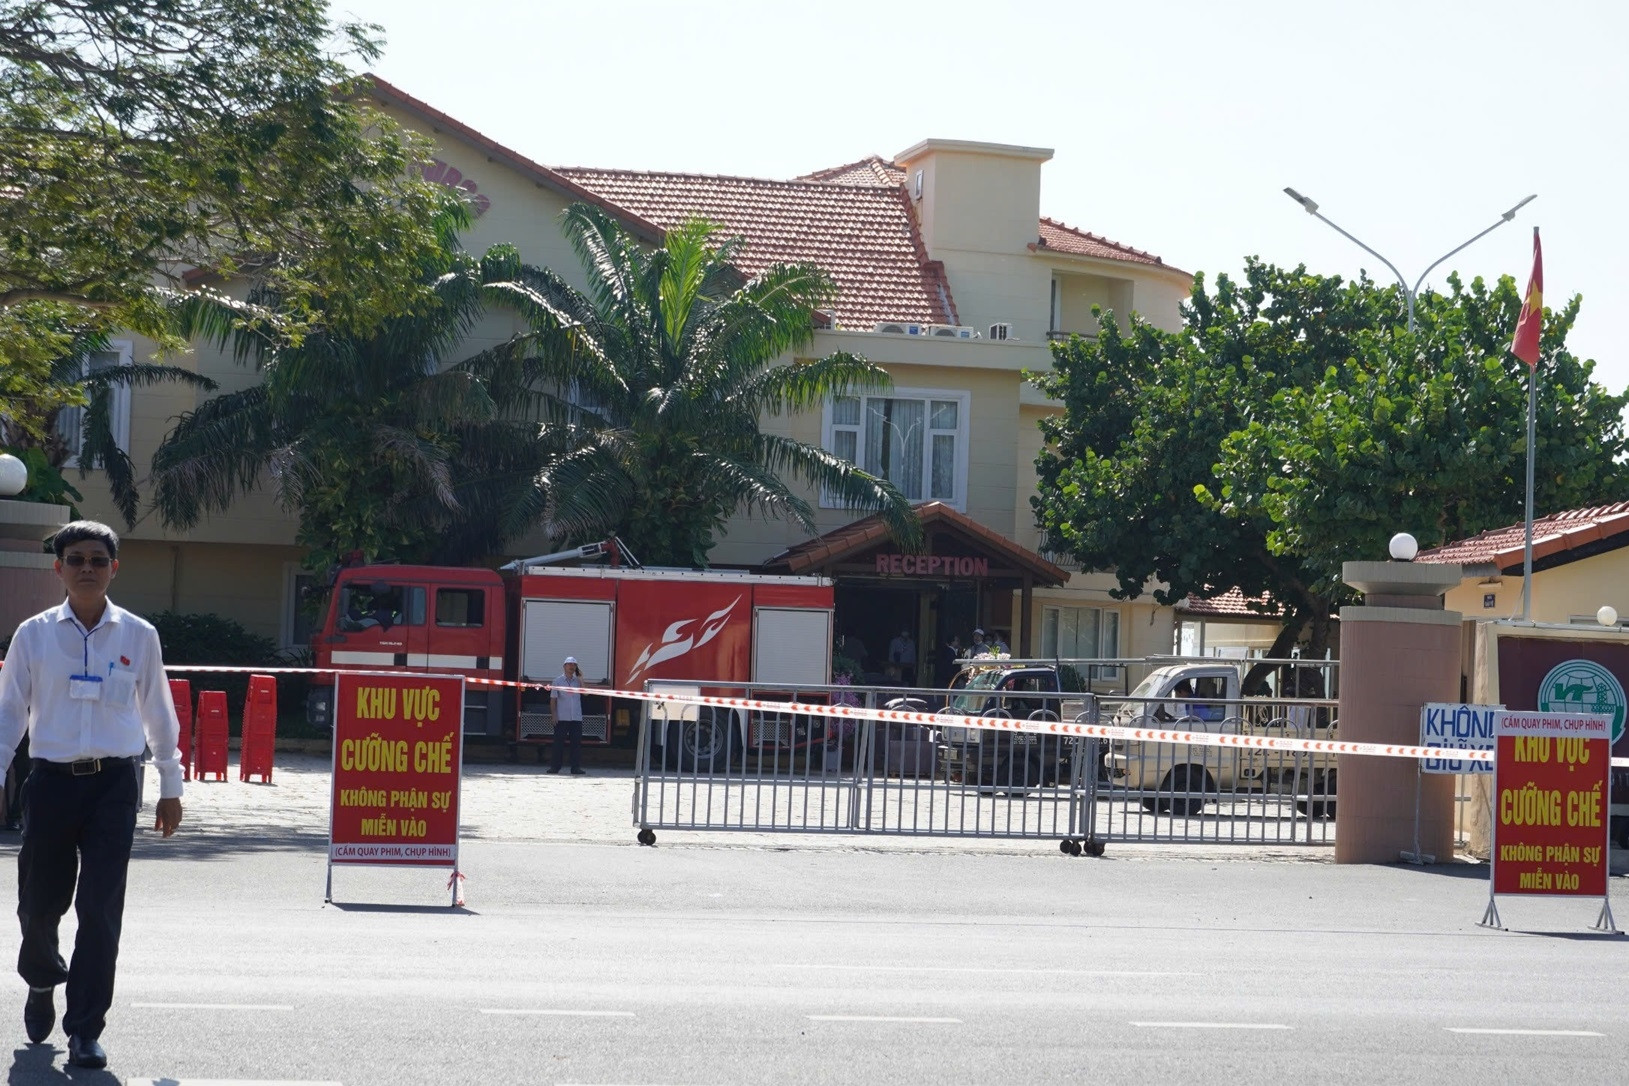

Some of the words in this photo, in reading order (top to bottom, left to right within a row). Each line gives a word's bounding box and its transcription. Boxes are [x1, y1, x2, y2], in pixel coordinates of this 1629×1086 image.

[876, 554, 989, 576] RECEPTION
[356, 687, 397, 719] KHU
[402, 686, 440, 727] VỰC
[1521, 718, 1541, 729] QUAY
[1542, 719, 1563, 731] PHIM,
[1564, 719, 1583, 733] CHỤP
[341, 732, 408, 772] CƯỠNG
[414, 732, 455, 773] CHẾ
[1514, 736, 1550, 763] KHU
[340, 786, 387, 807] KHÔNG
[390, 788, 428, 812] PHẬN
[431, 790, 452, 812] SỰ
[1501, 781, 1562, 826] CƯỠNG
[1567, 780, 1603, 827] CHẾ
[361, 813, 397, 836] MIỄN
[401, 816, 427, 837] VÀO
[357, 847, 379, 857] QUAY
[381, 848, 403, 858] PHIM,
[404, 847, 427, 858] CHỤP
[1500, 842, 1543, 862] KHÔNG
[1546, 843, 1580, 867] PHẬN
[1583, 845, 1602, 867] SỰ
[1520, 867, 1552, 889] MIỄN
[1556, 870, 1580, 890] VÀO
